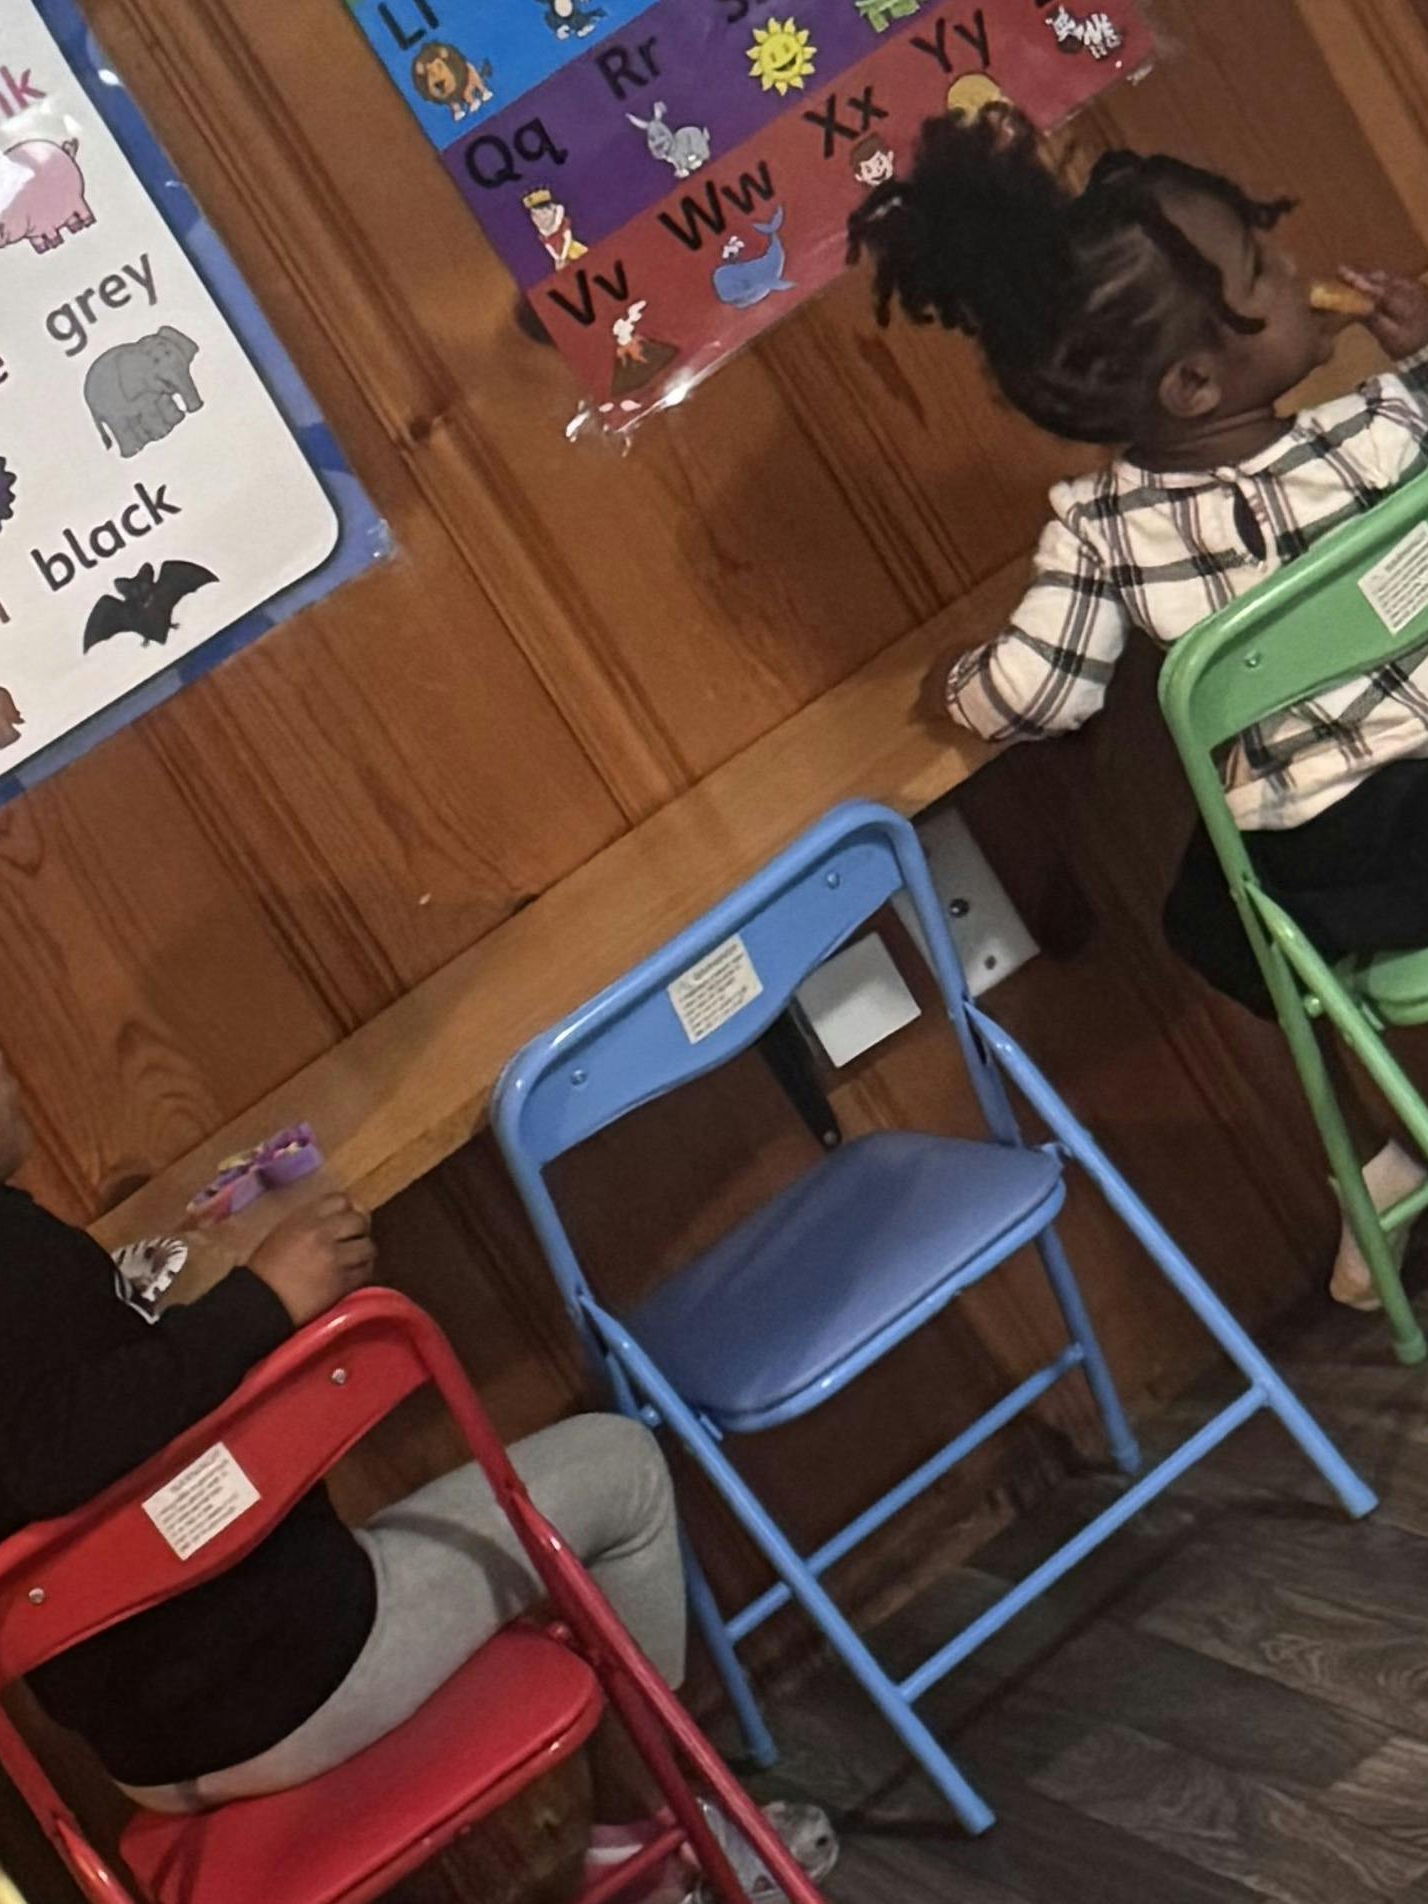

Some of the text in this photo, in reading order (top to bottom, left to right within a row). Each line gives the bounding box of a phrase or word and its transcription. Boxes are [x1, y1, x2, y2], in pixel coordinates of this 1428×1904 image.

[464, 117, 569, 190] Qq
[593, 36, 662, 101] Rr
[547, 261, 629, 327] Vv
[657, 160, 776, 253] Ww
[802, 85, 890, 159] Xx
[910, 9, 993, 74] Yy
[44, 253, 161, 357] grey
[30, 482, 183, 592] black
